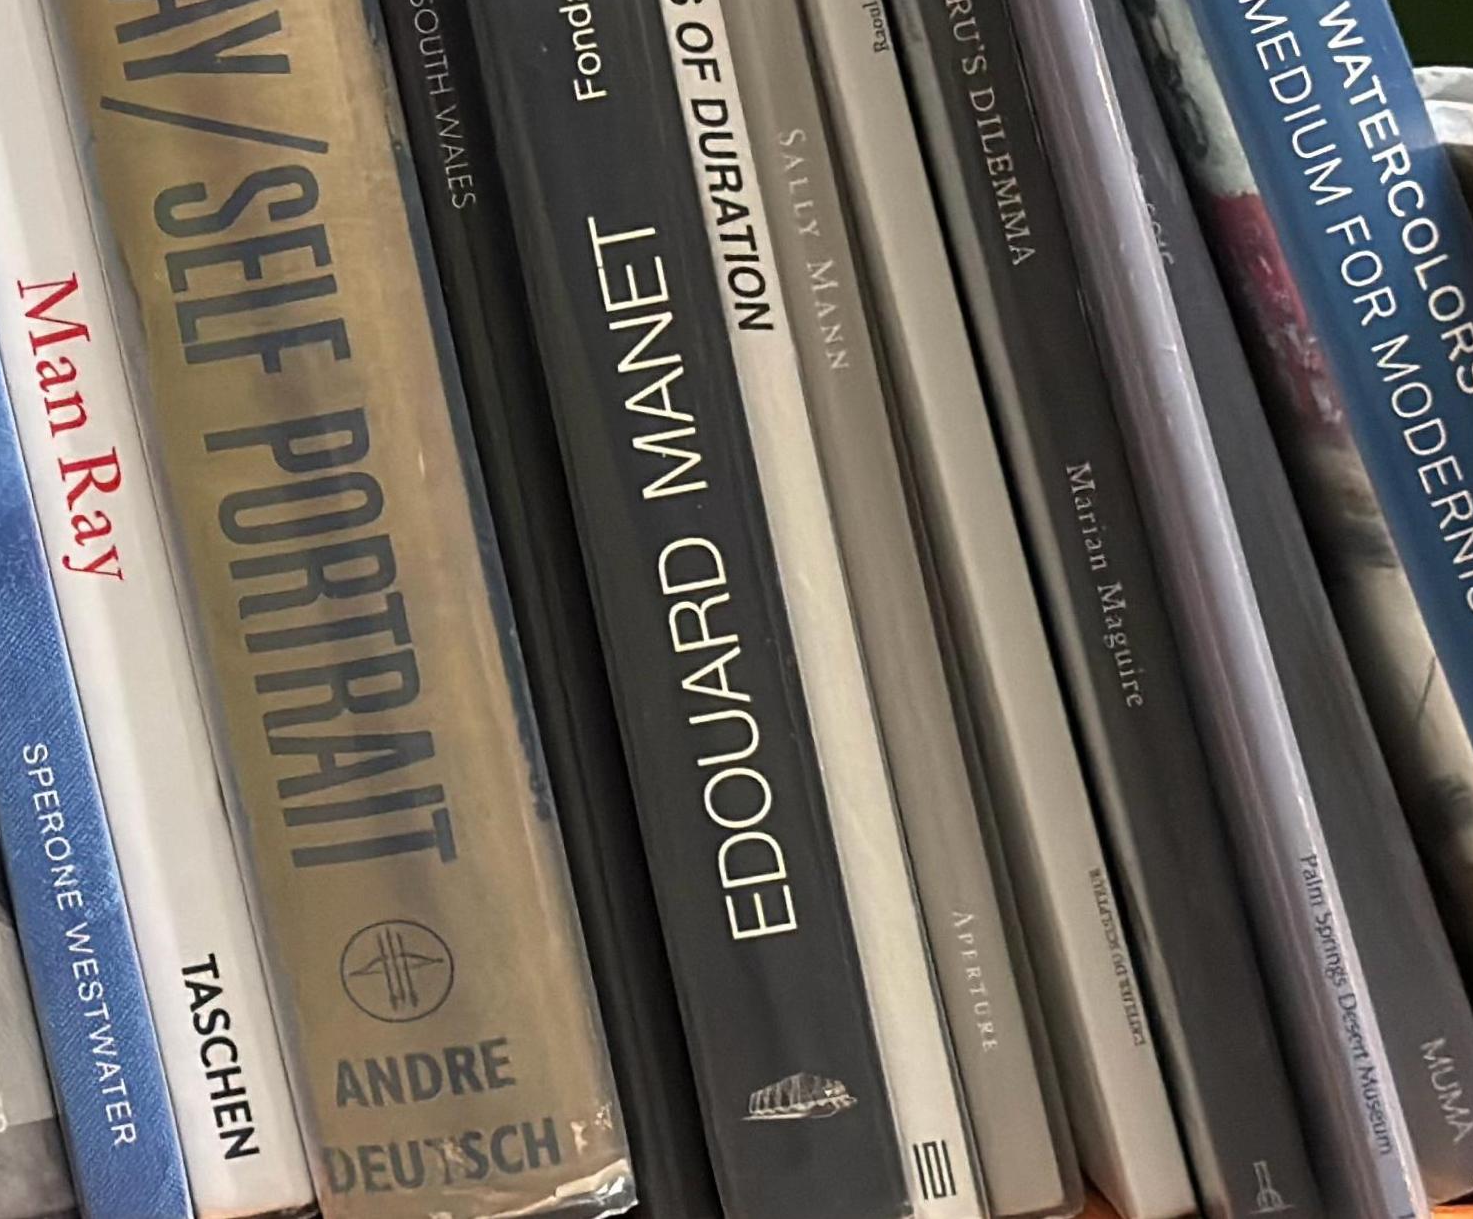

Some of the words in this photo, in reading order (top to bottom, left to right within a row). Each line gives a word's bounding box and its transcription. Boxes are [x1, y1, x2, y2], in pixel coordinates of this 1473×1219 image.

[679, 22, 719, 87] OF
[862, 0, 890, 53] Raoul
[435, 104, 477, 210] WALES
[689, 98, 775, 332] DURATION
[778, 127, 820, 241] SALLY
[806, 260, 851, 372] MANN
[968, 88, 1034, 270] DILEMMA
[588, 216, 708, 500] MANET
[1324, 218, 1400, 328] FOR
[16, 271, 93, 442] Man
[56, 442, 125, 582] Ray
[204, 407, 458, 870] PORTRAIT
[1066, 462, 1110, 572] Marian
[1095, 582, 1143, 709] Maguire
[657, 534, 799, 942] EDOUARD
[21, 742, 87, 917] SPERONE
[67, 912, 136, 1148] WESTWATER
[952, 910, 999, 1054] APERTURE
[1300, 853, 1324, 908] Palm
[1314, 910, 1348, 988] Springs
[1357, 1064, 1394, 1156] Museum
[180, 954, 259, 1160] TASCHEN
[326, 1118, 562, 1197] DEUTSCH
[334, 1037, 516, 1108] ANDRE
[1420, 1036, 1473, 1143] MUMA
